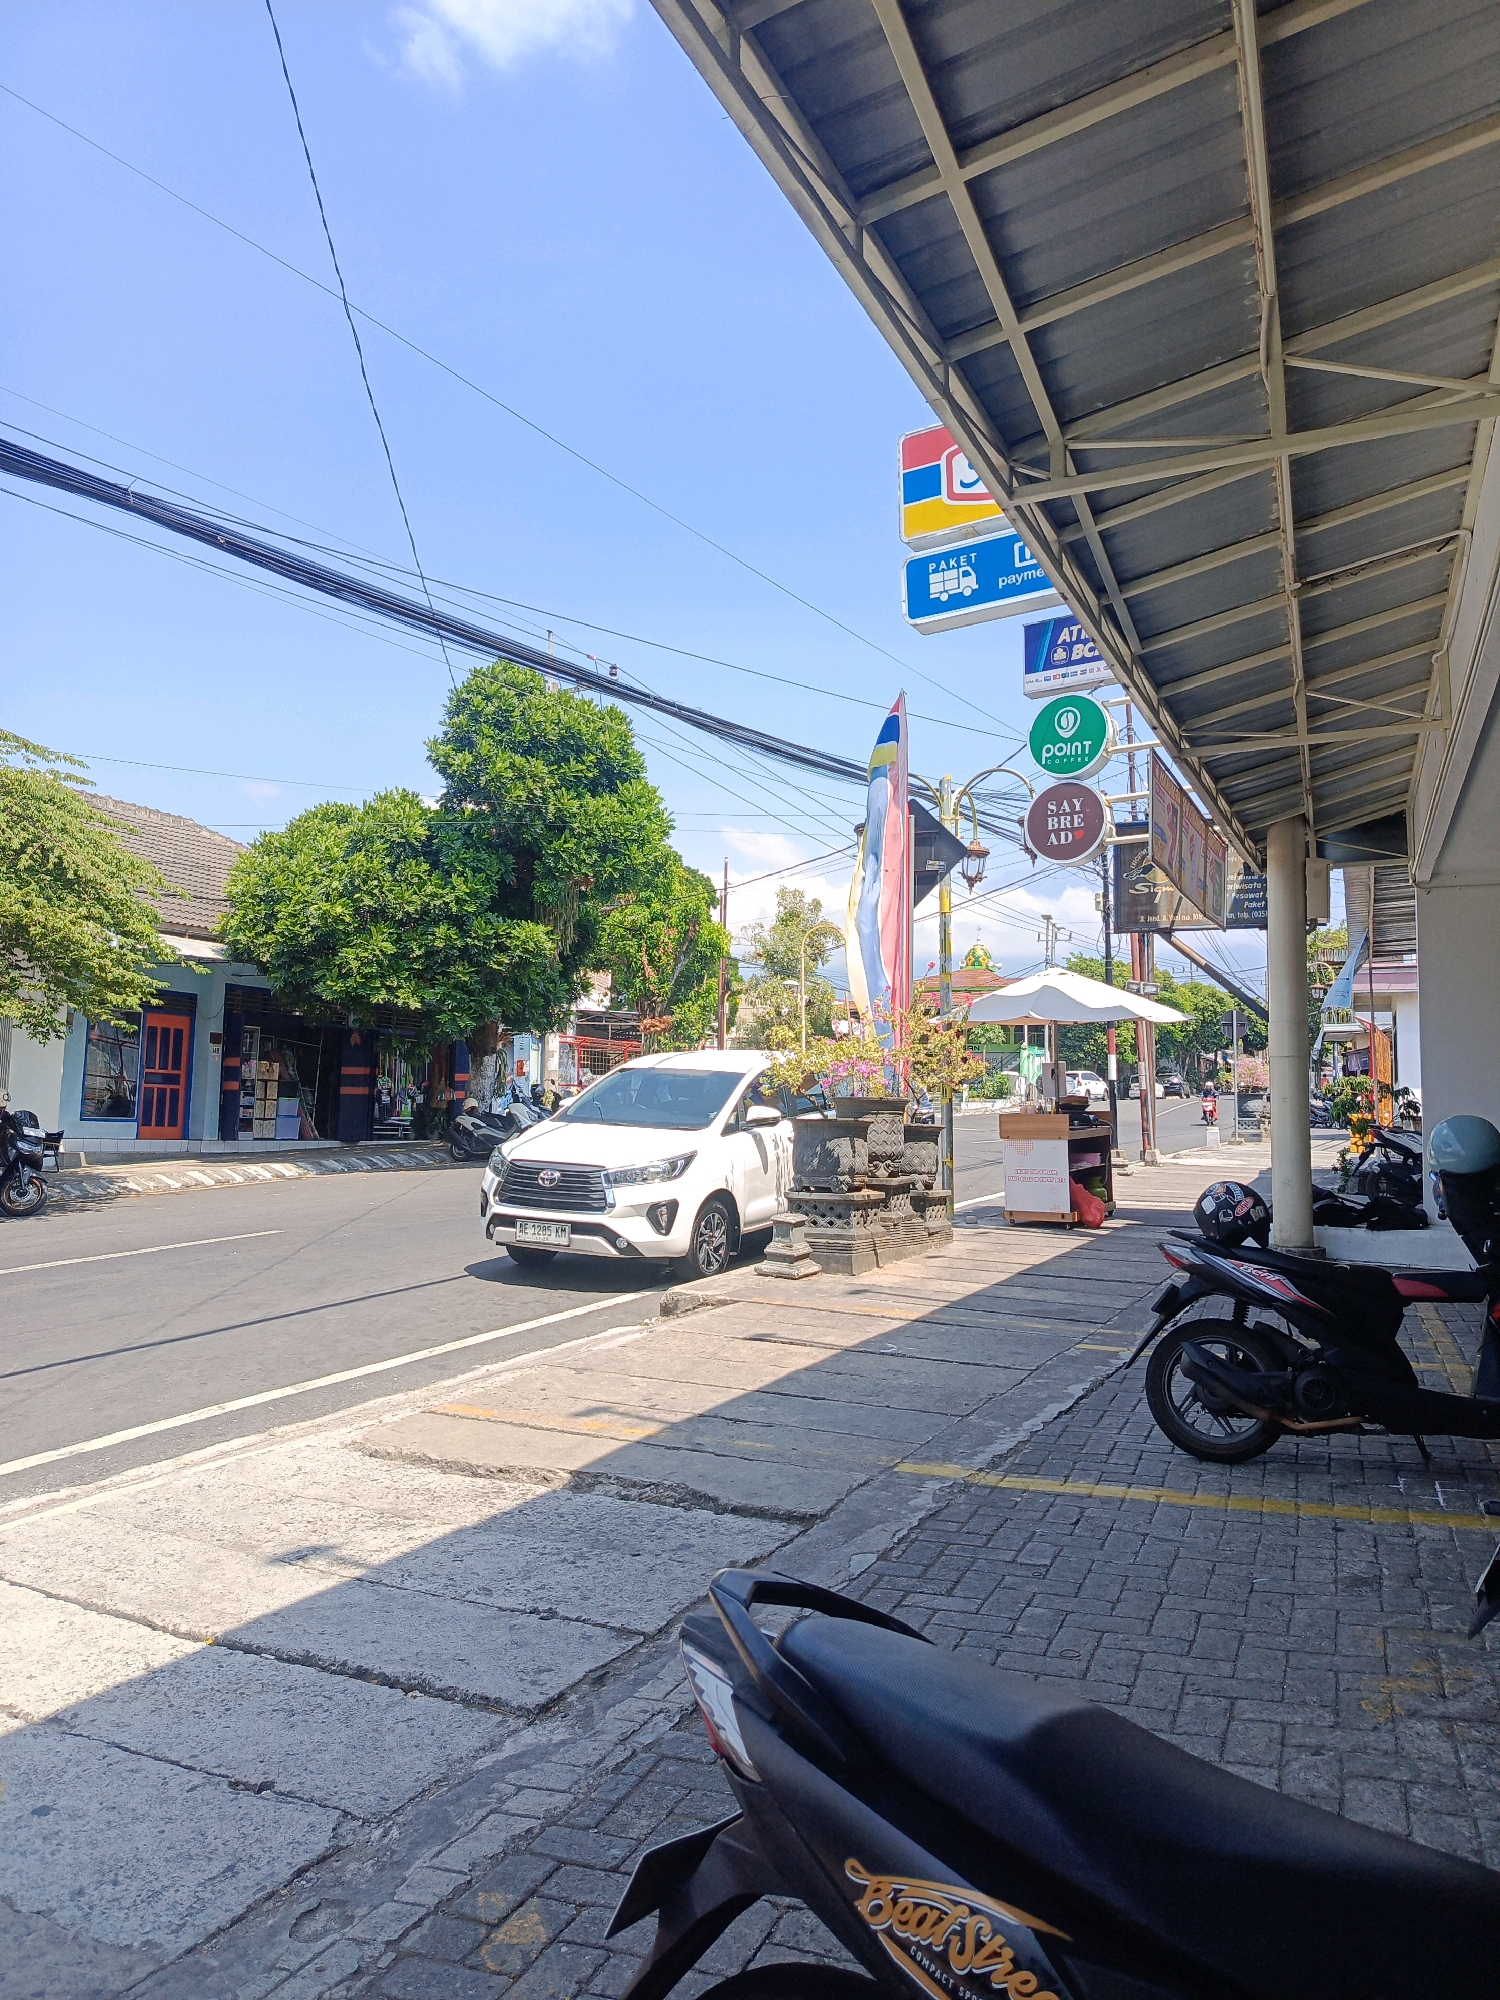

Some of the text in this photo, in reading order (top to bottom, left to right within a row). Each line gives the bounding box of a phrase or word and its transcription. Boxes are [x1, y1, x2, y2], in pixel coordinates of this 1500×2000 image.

[928, 552, 977, 573] PAKET
[1041, 741, 1092, 764] POINT
[1047, 756, 1089, 764] COFFEE
[1047, 797, 1084, 815] SAY
[1047, 813, 1084, 830] BRE
[1047, 830, 1073, 846] AD
[1231, 891, 1264, 899] Pesawat
[1243, 901, 1266, 909] Paket
[519, 1222, 567, 1239] AE 1285 KM
[855, 1881, 1061, 2000] Beat Stre
[909, 1945, 985, 2000] COMPACT SPO
